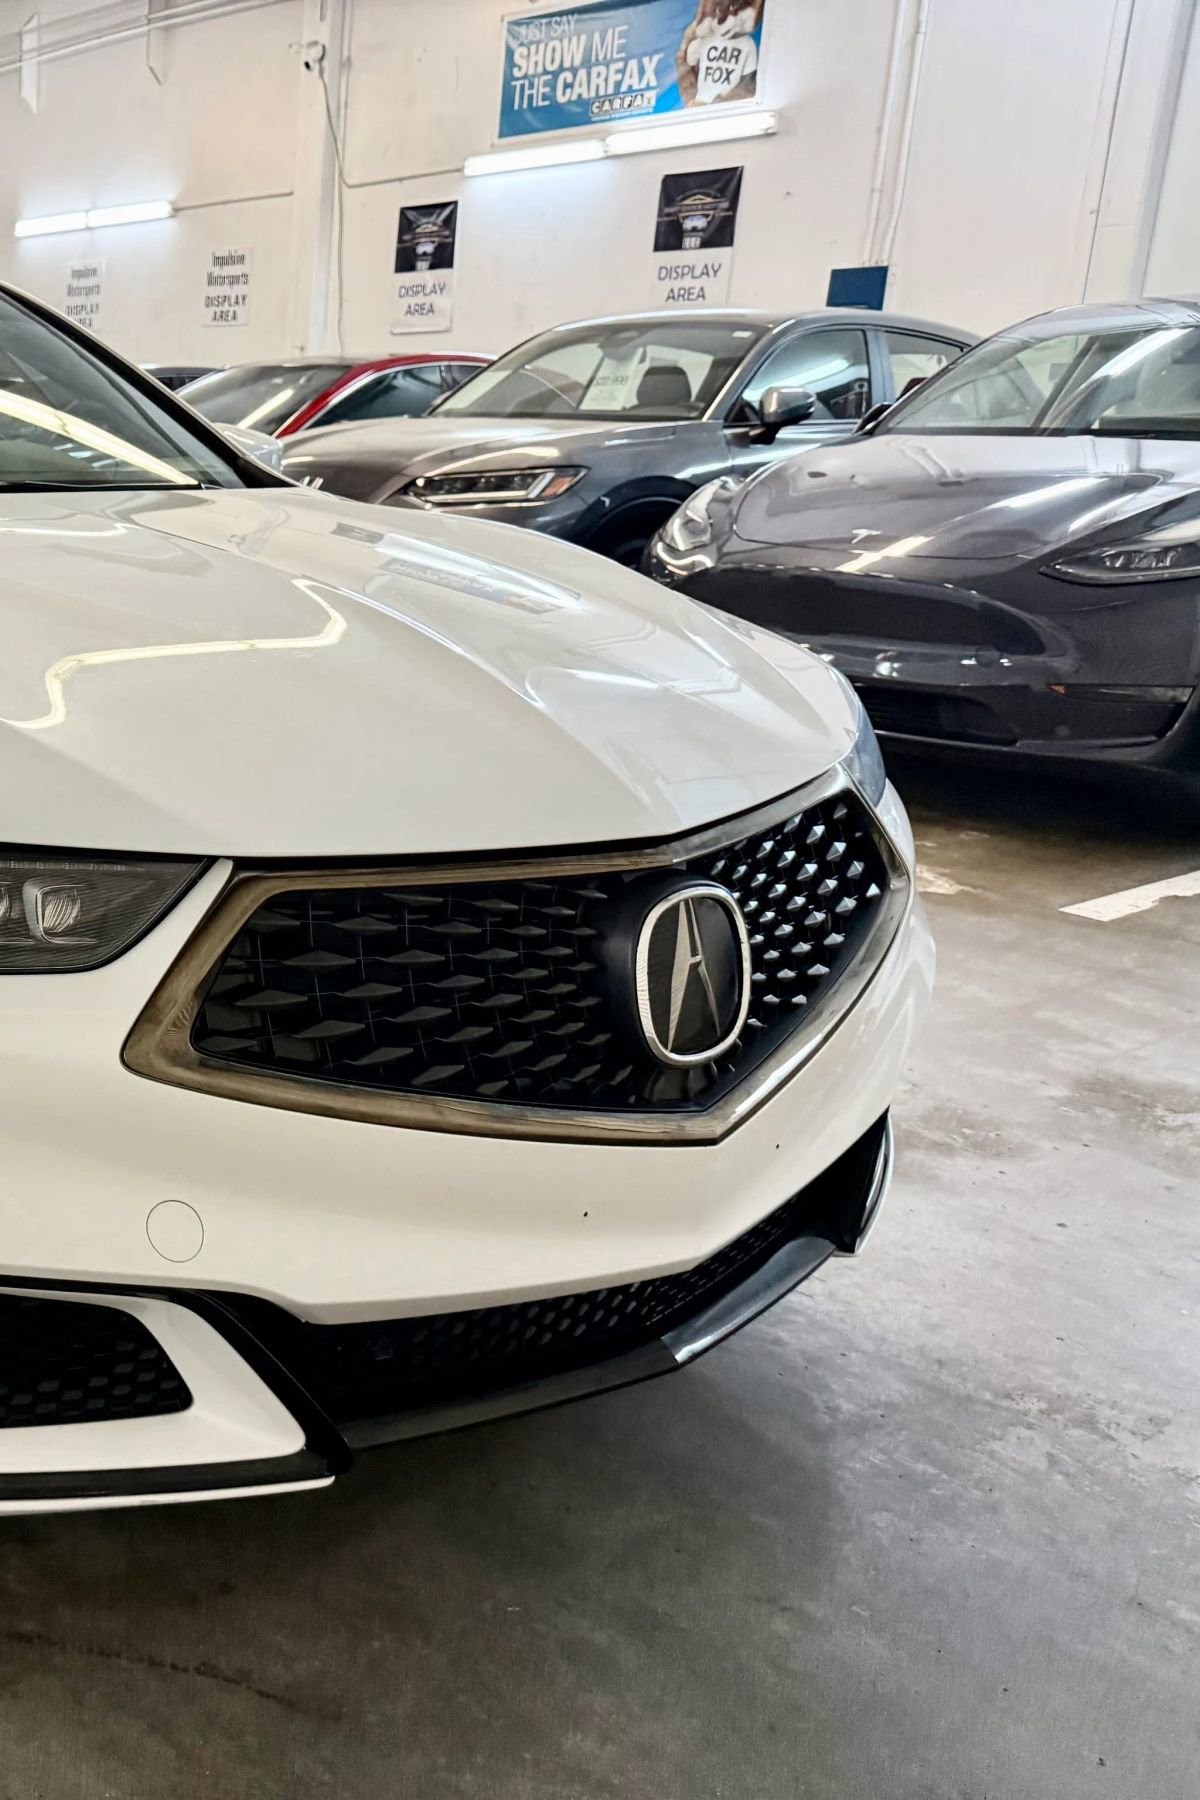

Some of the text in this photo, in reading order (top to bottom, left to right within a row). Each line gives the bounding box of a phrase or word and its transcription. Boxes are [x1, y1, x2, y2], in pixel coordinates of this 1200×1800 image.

[517, 14, 577, 42] JUST SAY
[513, 25, 628, 77] SHOW ME
[707, 46, 741, 64] CAR
[512, 55, 661, 110] THE CARFAX
[704, 66, 735, 85] FOX
[658, 263, 722, 281] DISPLAY
[398, 283, 446, 298] DISPLAY
[665, 286, 706, 302] AREA
[205, 295, 248, 308] DISPLAY
[405, 303, 435, 317] AREA
[212, 310, 238, 322] AREA
